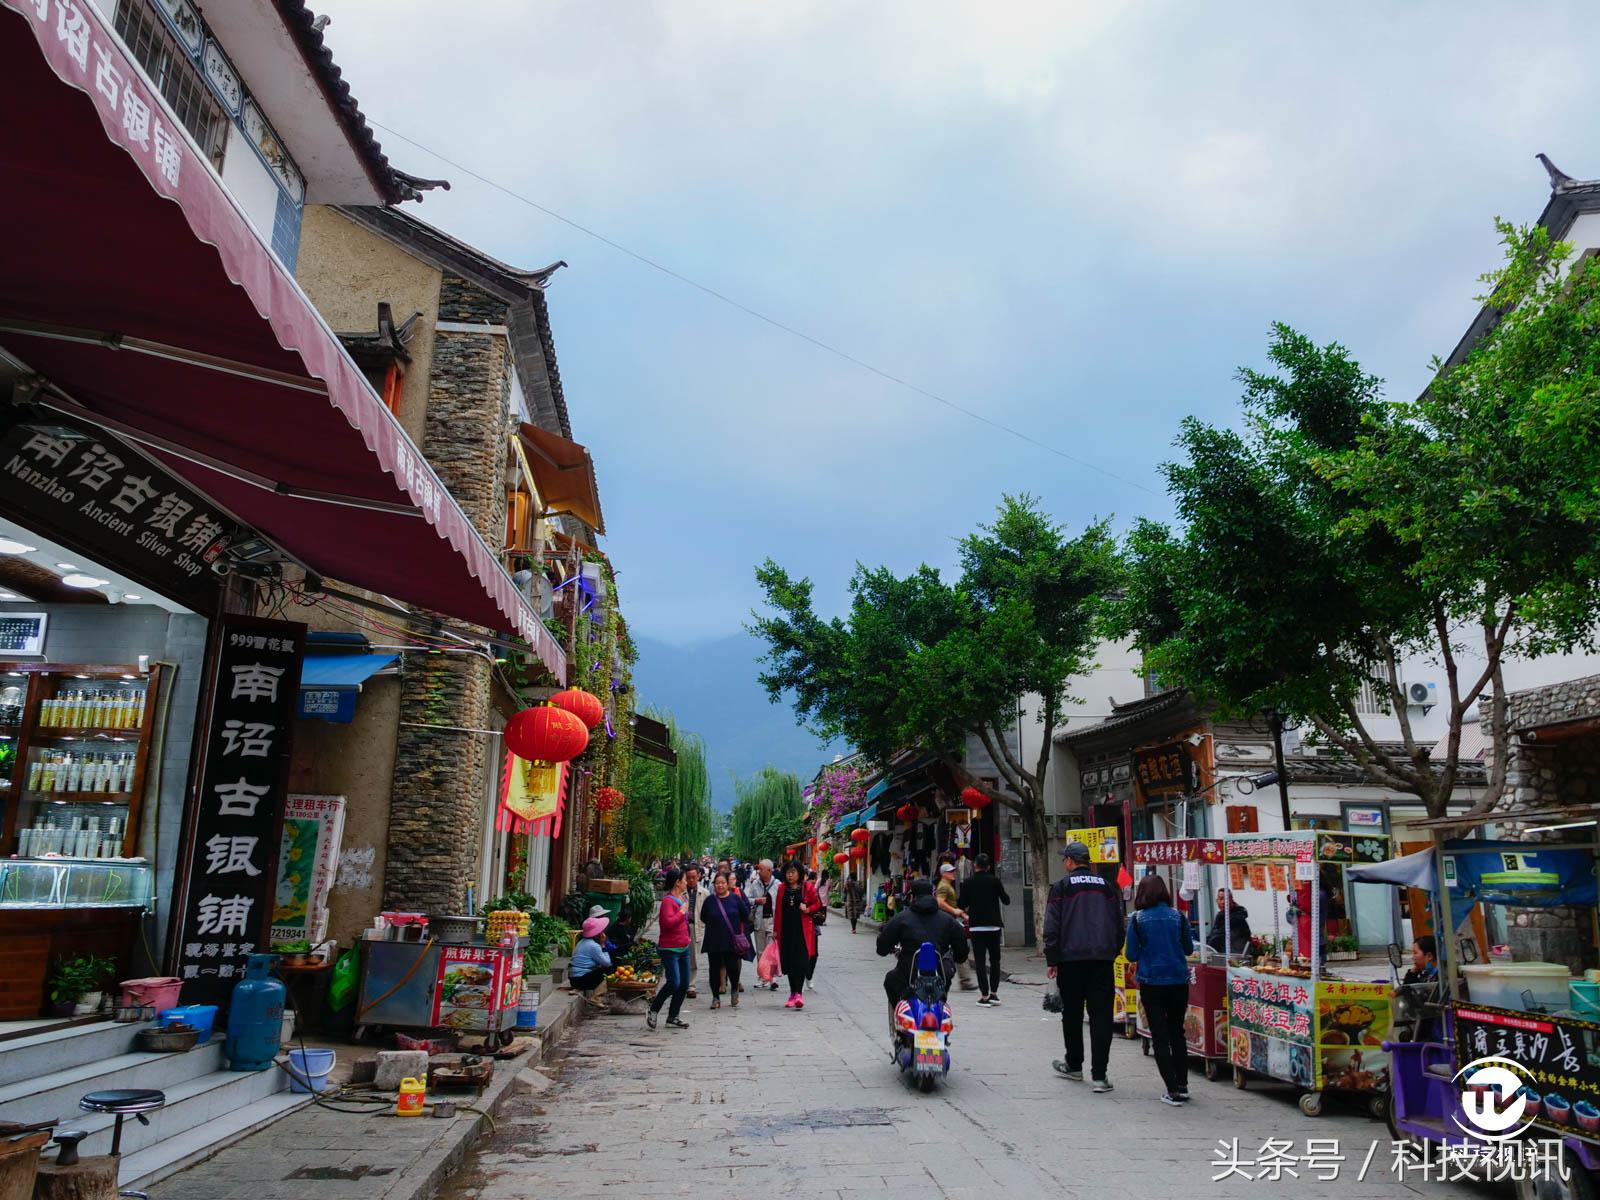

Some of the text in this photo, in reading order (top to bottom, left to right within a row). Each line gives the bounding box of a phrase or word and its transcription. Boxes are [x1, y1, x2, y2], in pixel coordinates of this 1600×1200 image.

[21, 433, 224, 555] 南诏古银铺
[4, 454, 75, 504] Nanzhao
[78, 499, 136, 537] Ancient
[136, 530, 173, 558] Silver
[173, 552, 203, 577] Shop
[197, 661, 286, 936] 南诏古银铺
[1070, 875, 1106, 885] DICKIES
[185, 942, 255, 958] 现场鉴定
[445, 946, 500, 961] 煎饼果子
[1231, 975, 1310, 1007] 云南烧饵块
